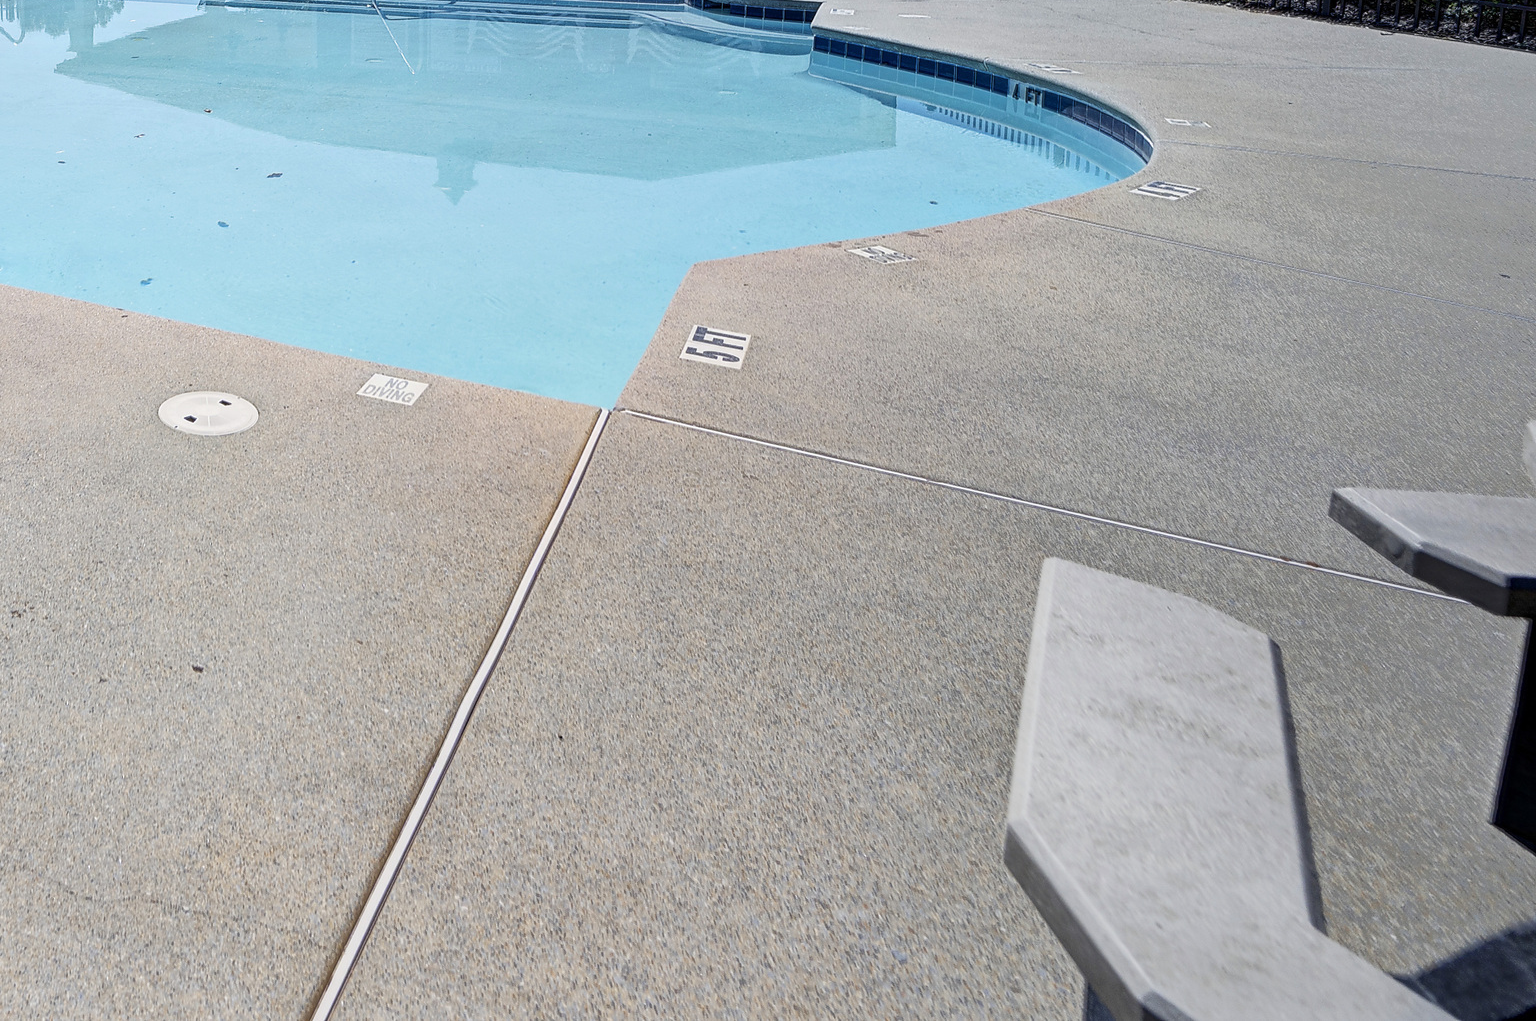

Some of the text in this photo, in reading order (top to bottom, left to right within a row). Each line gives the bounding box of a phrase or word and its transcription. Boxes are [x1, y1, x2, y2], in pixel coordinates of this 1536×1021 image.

[1025, 86, 1041, 106] FT
[685, 325, 747, 363] 5 FT
[362, 384, 415, 403] DIVING
[384, 378, 409, 390] NO
